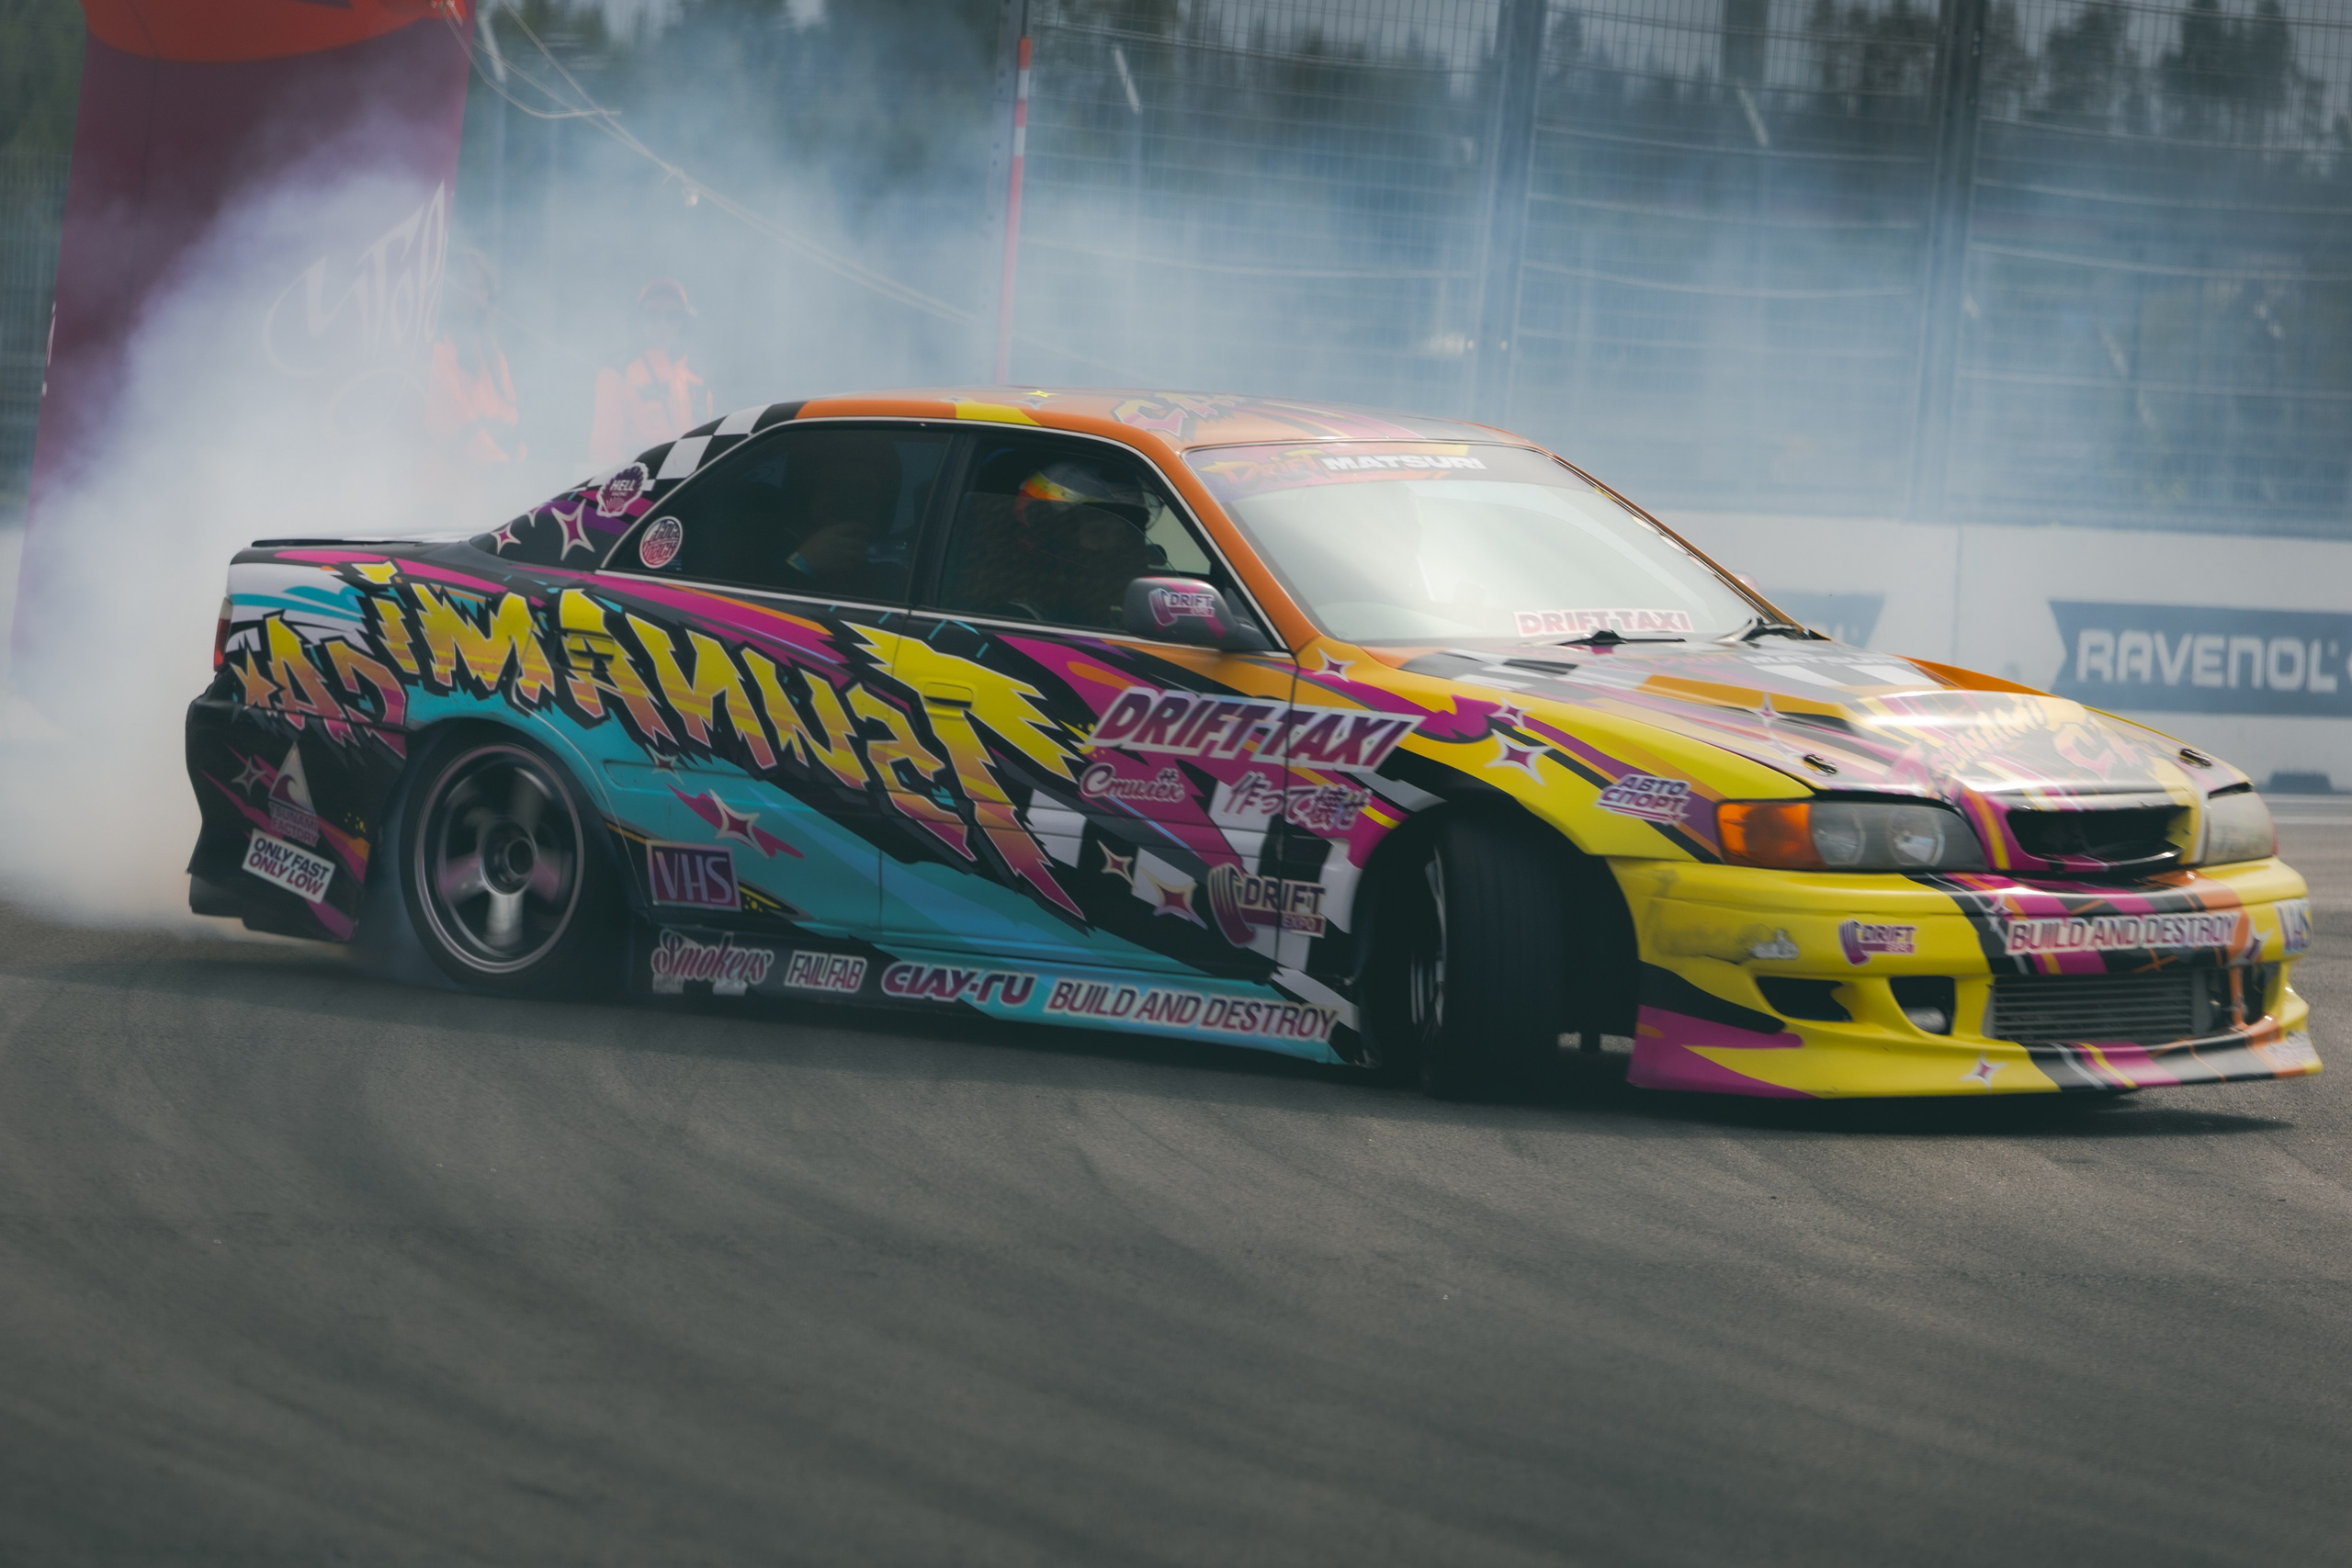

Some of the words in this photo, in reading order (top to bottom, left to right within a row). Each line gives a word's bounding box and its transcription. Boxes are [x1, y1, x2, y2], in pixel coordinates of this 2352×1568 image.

[1321, 456, 1487, 471] MATSURI
[610, 479, 637, 491] HELL
[1170, 594, 1214, 607] DRIFT
[1517, 612, 1609, 635] DRIFT
[1614, 611, 1692, 631] TAXI
[2075, 628, 2338, 694] RAVENOL
[249, 852, 289, 878] ONLY
[286, 869, 324, 896] LOW
[254, 837, 293, 863] ONLY
[291, 853, 330, 881] FAST
[655, 851, 732, 904] VHS
[1243, 876, 1325, 916] DRIFT
[1861, 925, 1917, 942] DRIFT
[2009, 919, 2087, 953] BUILD
[2089, 915, 2143, 949] AND
[2142, 910, 2237, 946] DESTROY
[1048, 980, 1136, 1019] BUILD
[1135, 992, 1201, 1025] AND
[1201, 1000, 1338, 1040] DESTROY
